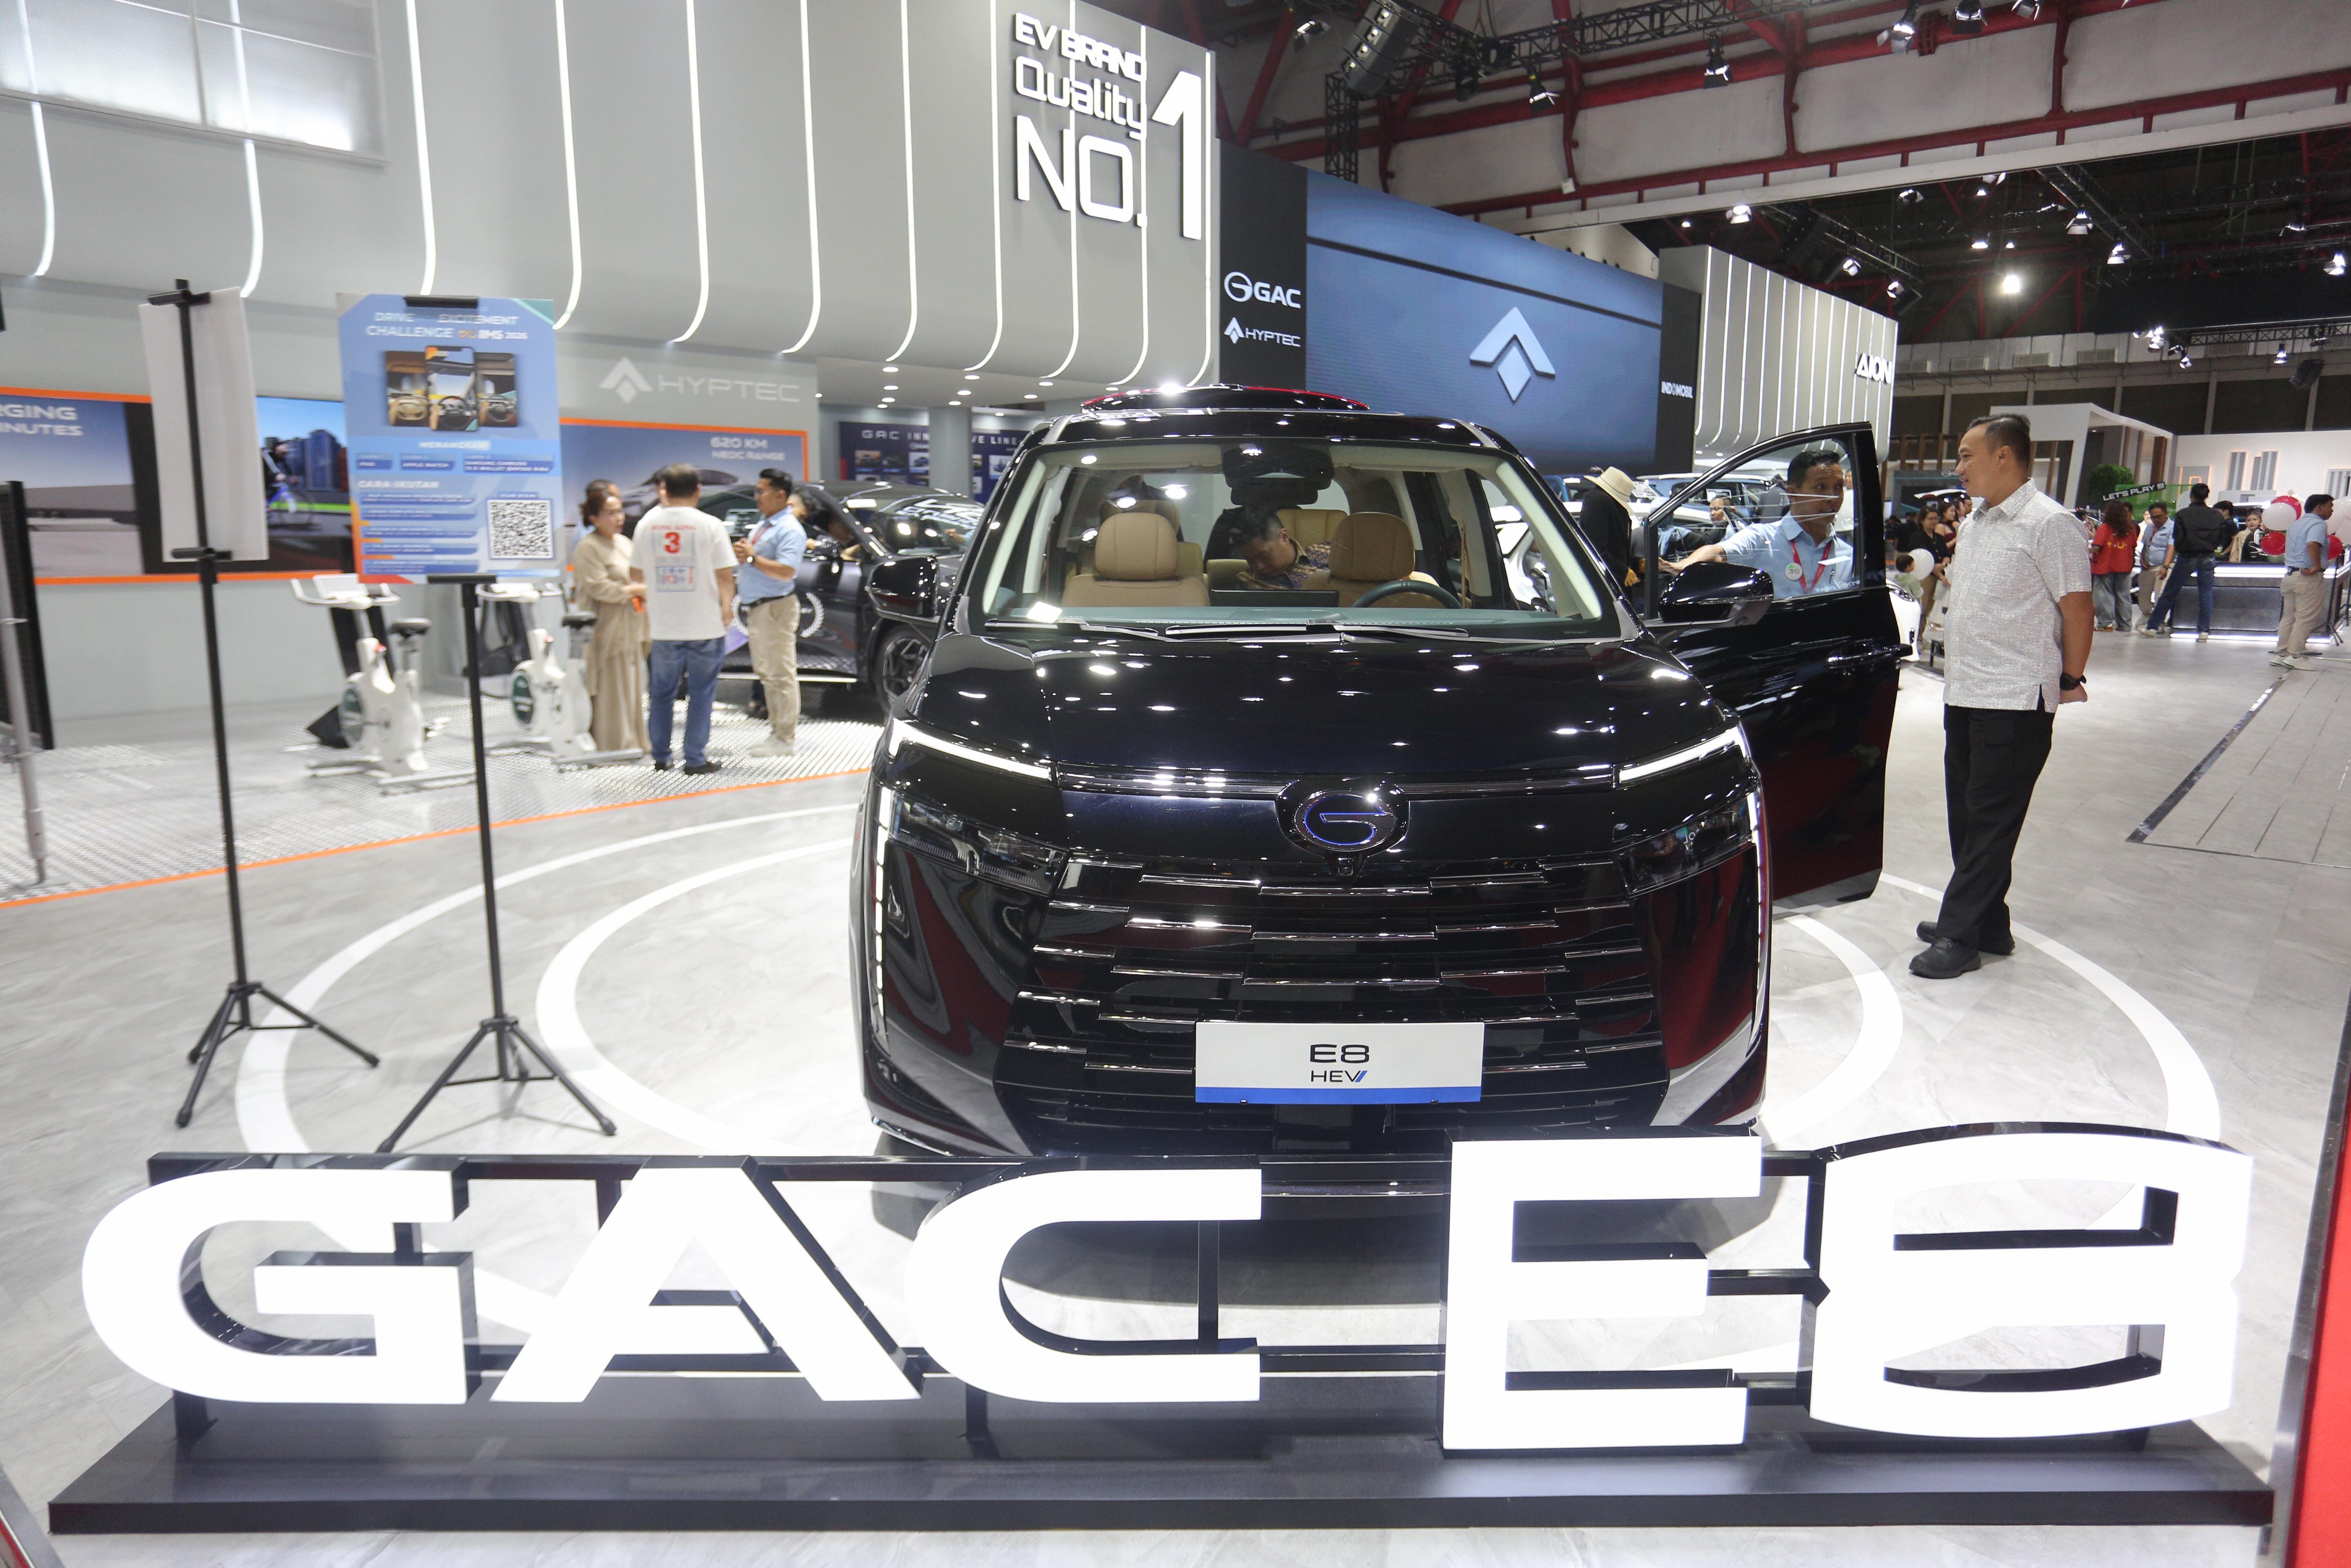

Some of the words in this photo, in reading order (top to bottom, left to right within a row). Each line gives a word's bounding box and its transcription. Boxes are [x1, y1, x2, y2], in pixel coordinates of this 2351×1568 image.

[1016, 13, 1058, 50] EV
[1062, 29, 1147, 82] BRAND
[1016, 56, 1147, 140] Quality
[1151, 70, 1202, 240] 1
[1254, 281, 1301, 309] GAC
[366, 325, 455, 338] CHALLENGE
[1245, 327, 1301, 347] HYPTEC
[1856, 352, 1892, 384] AION
[658, 374, 800, 403] HYPTEC
[1661, 381, 1693, 399] INDOMOBIL
[0, 404, 78, 421] GING
[710, 437, 743, 448] 620
[744, 439, 768, 449] KM
[862, 430, 900, 440] GAC
[746, 451, 785, 461] RANGE
[2103, 490, 2129, 501] LET'S
[2130, 485, 2155, 495] PLAY
[664, 532, 680, 554] 3
[1310, 1044, 1369, 1063] E8
[1311, 1070, 1362, 1082] HEV
[80, 1166, 1263, 1405] GAC
[1442, 1132, 2254, 1450] E8
